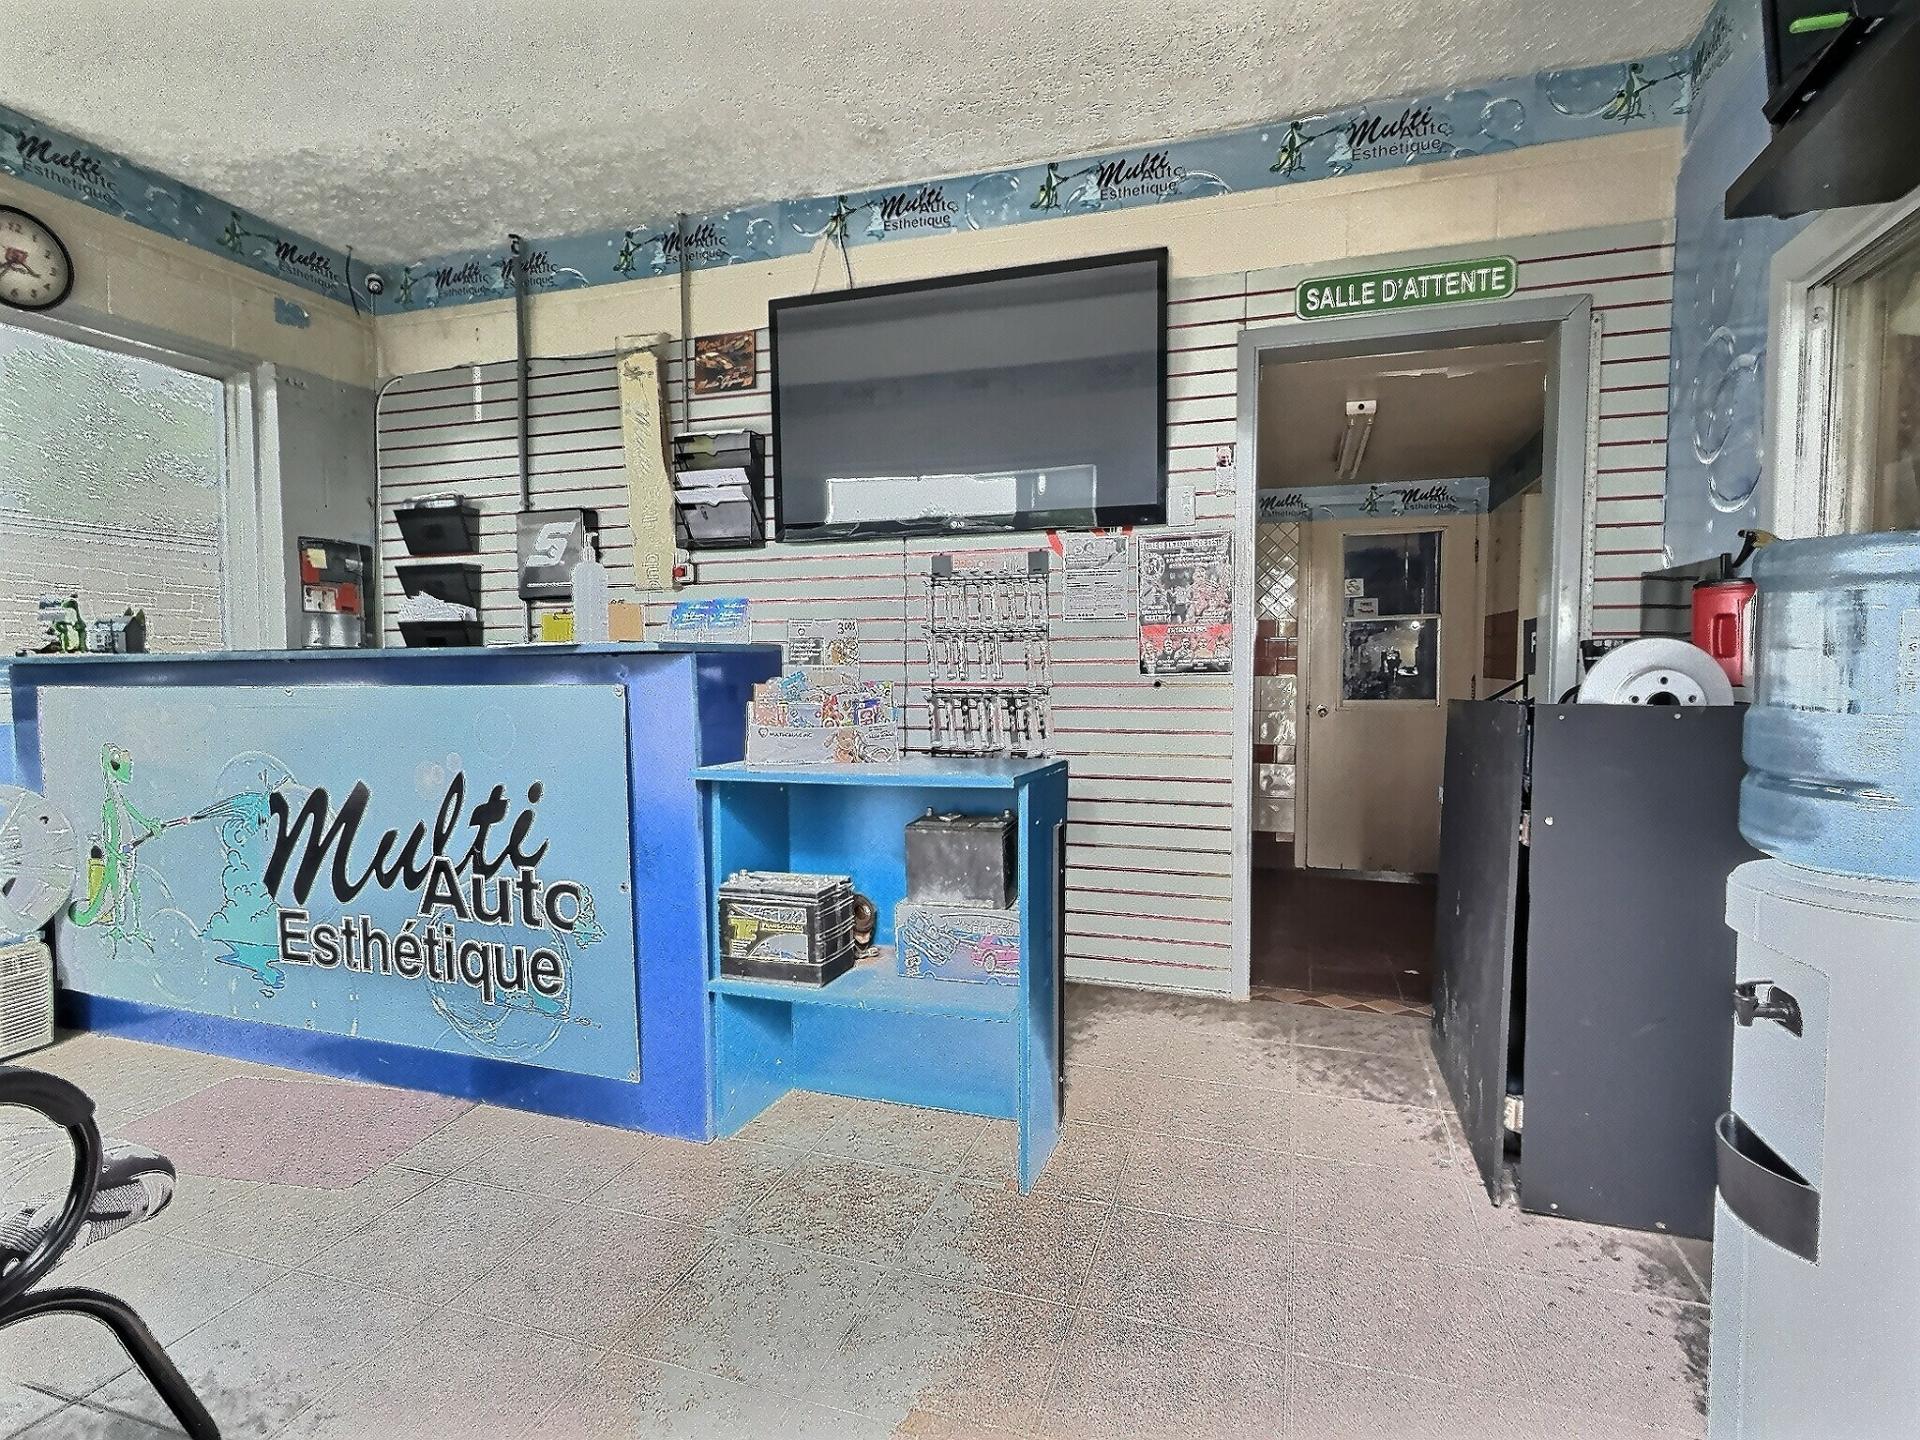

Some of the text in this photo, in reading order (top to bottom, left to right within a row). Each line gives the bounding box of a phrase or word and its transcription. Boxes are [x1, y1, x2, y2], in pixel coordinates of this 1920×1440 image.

[1348, 106, 1432, 147] Multi
[16, 131, 101, 175] Multi
[1097, 150, 1169, 187] Multi
[880, 185, 943, 219] Multi
[275, 239, 331, 270] Multi
[663, 223, 716, 253] Multi
[436, 261, 480, 288] Multi
[1306, 266, 1506, 311] SALLE D'ATTENTE
[263, 770, 549, 906] Multi
[418, 855, 583, 932] Auto
[277, 907, 566, 1005] Esthétique
